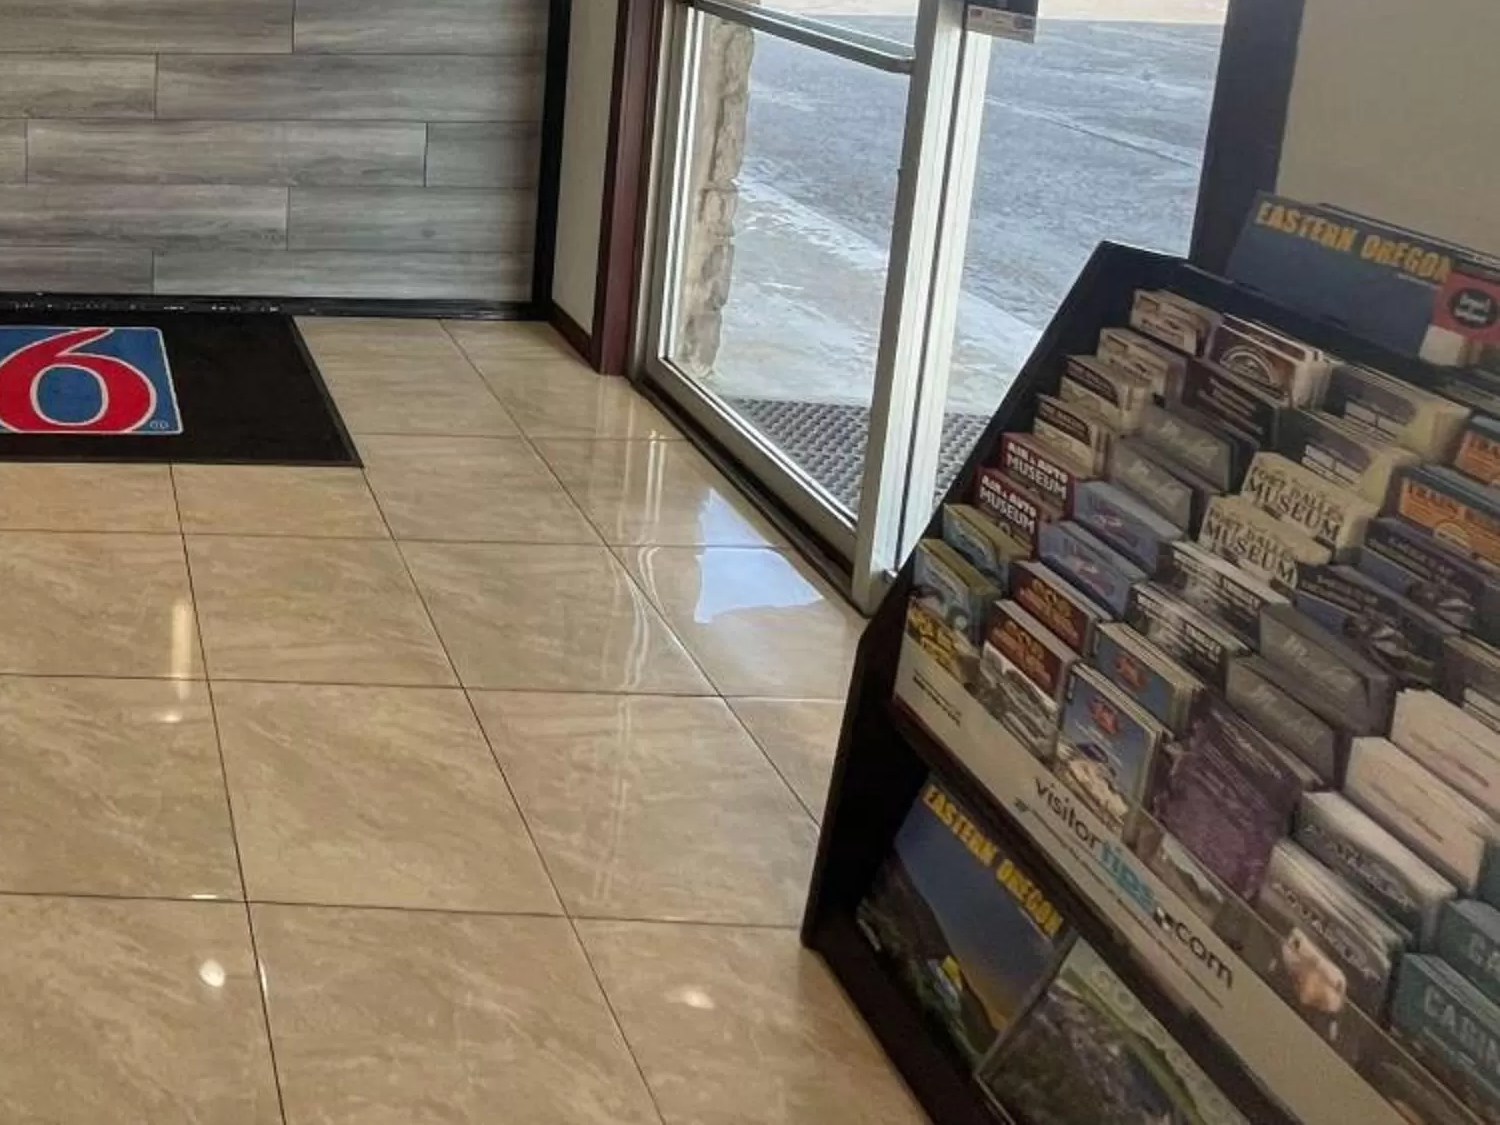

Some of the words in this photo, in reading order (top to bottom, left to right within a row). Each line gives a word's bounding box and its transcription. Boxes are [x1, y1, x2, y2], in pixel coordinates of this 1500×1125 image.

[1254, 201, 1358, 252] EASTERN
[1006, 454, 1067, 500] MUSEUM
[979, 483, 1035, 535] MUSEUM
[1245, 475, 1341, 542] MUSEUM
[1206, 520, 1299, 589] MUSEUM
[922, 783, 999, 867] EASTERN
[996, 857, 1065, 939] OREGON
